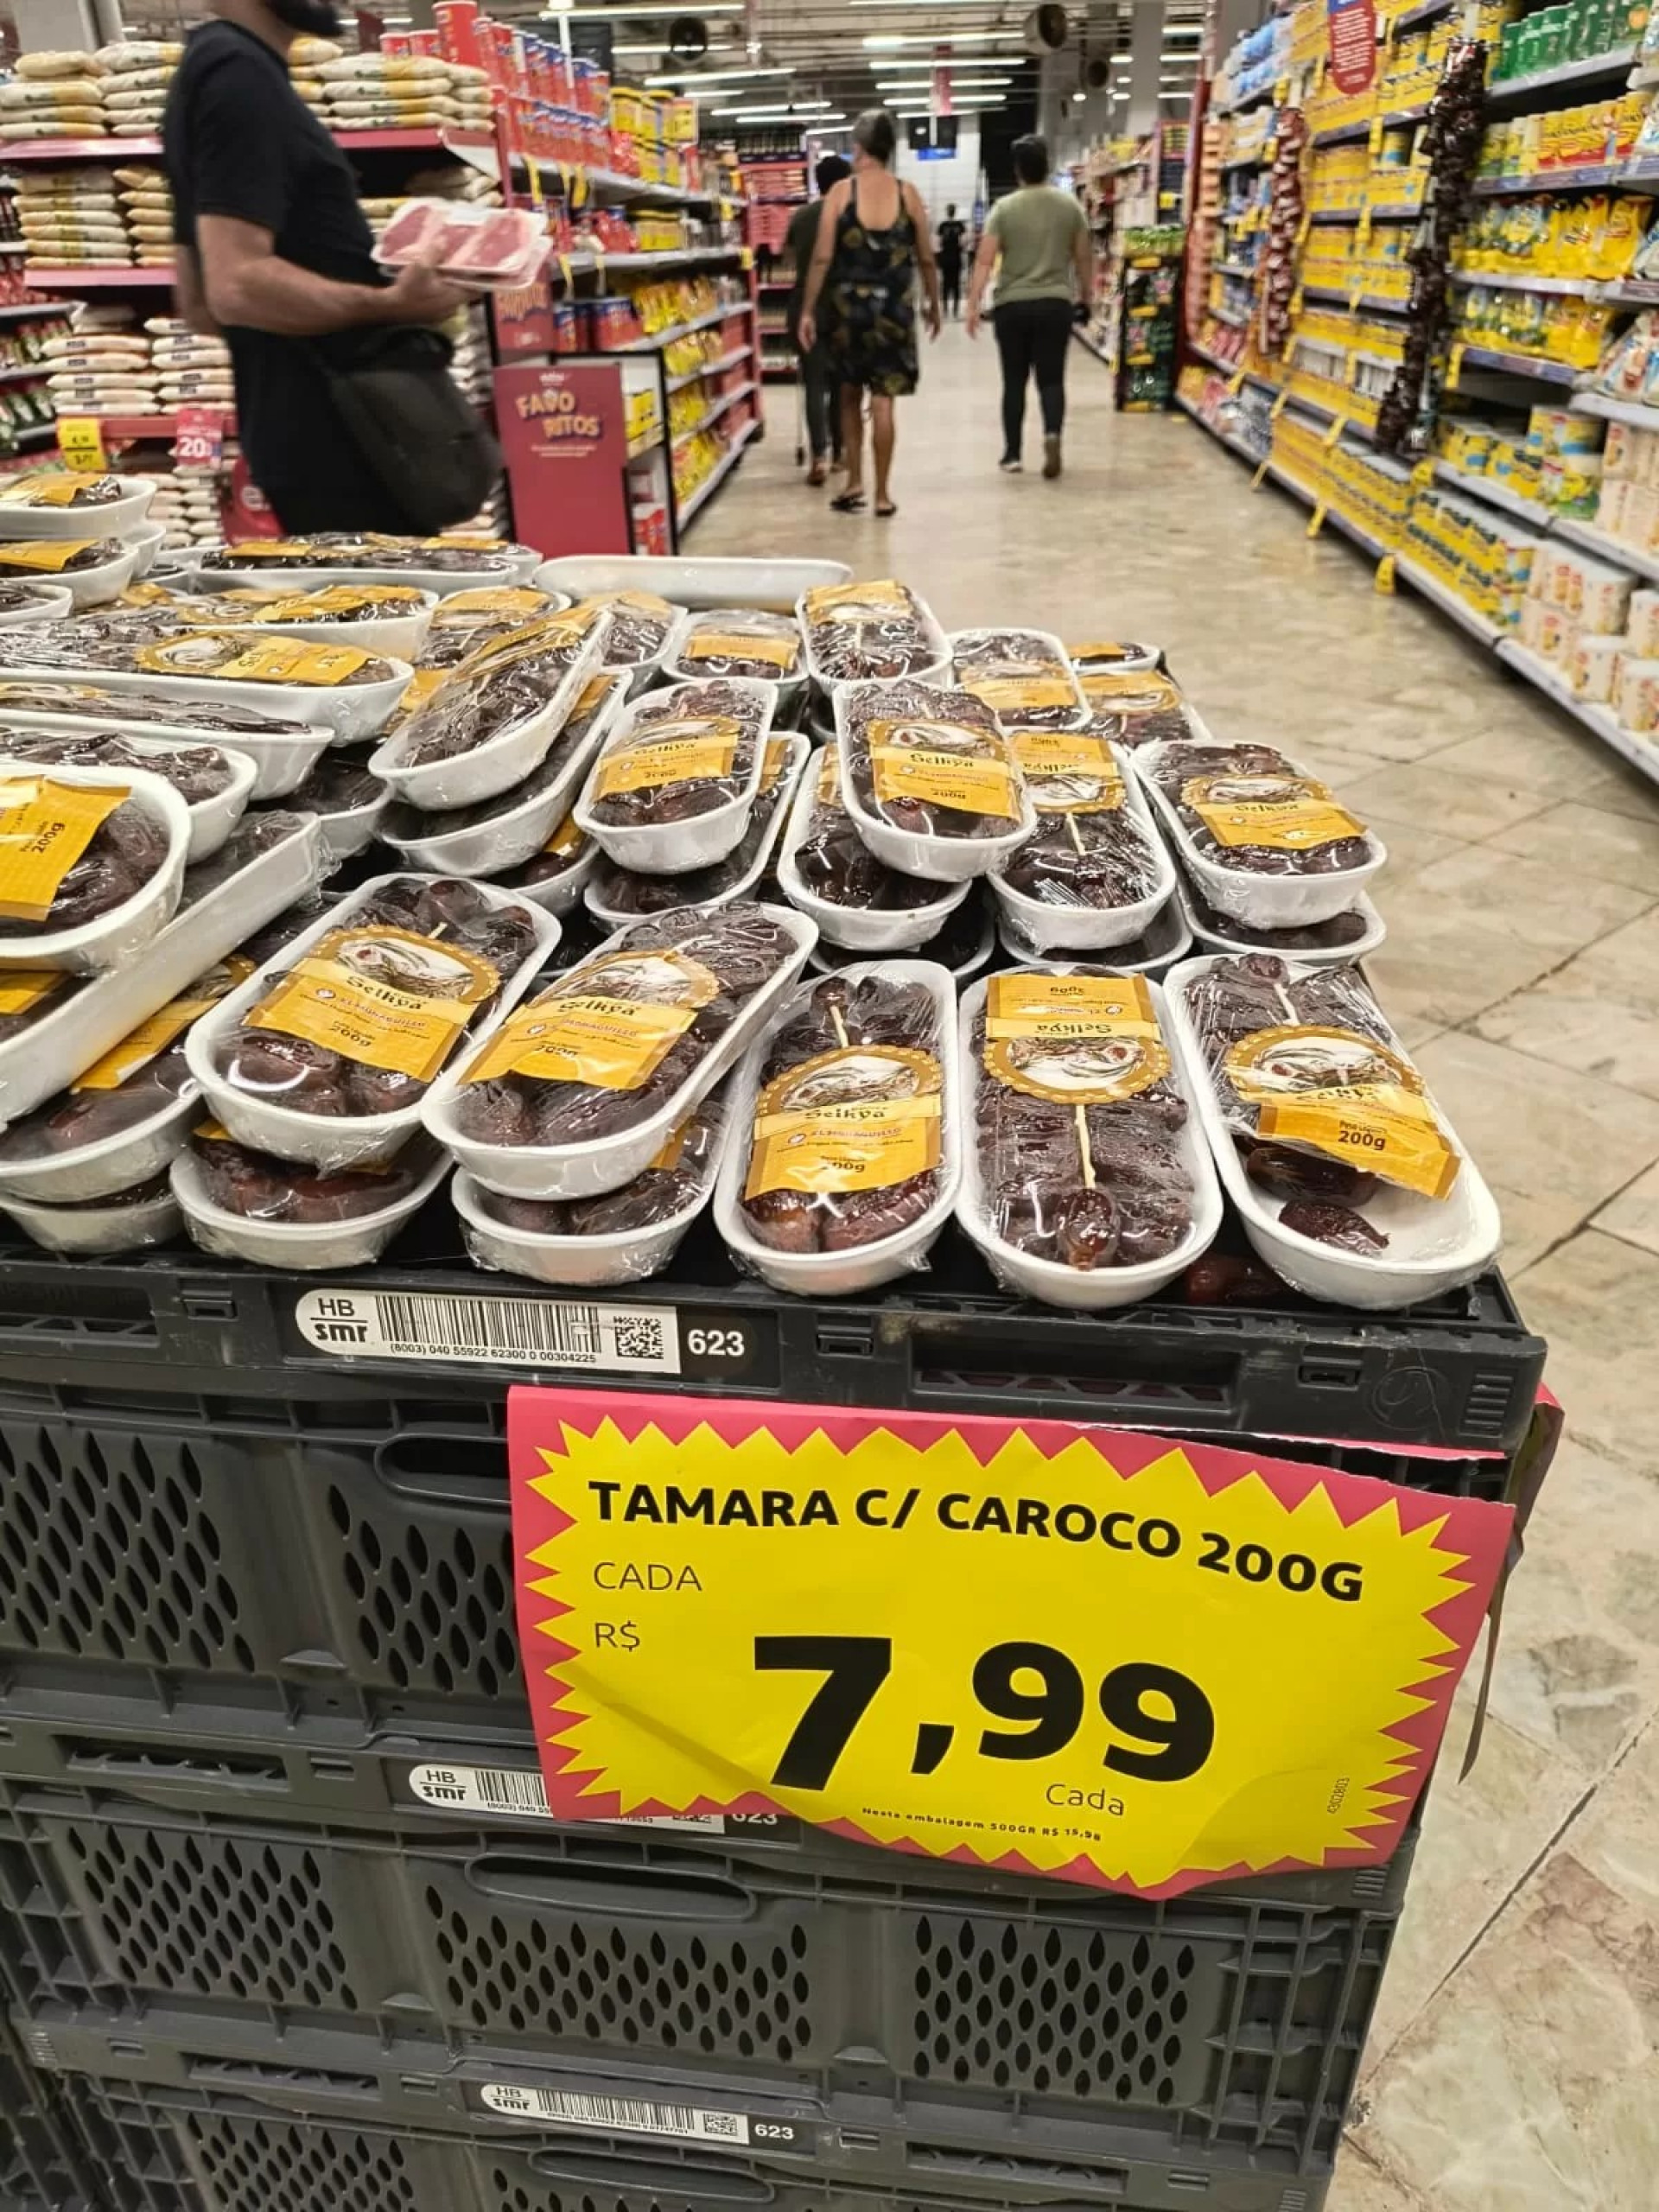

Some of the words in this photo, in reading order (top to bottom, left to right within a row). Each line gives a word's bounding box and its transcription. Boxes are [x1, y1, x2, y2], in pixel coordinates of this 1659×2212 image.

[31, 821, 67, 855] 200g
[1338, 1130, 1386, 1151] 200g
[318, 1298, 355, 1318] HB
[314, 1323, 369, 1344] smr
[688, 1330, 745, 1357] 623
[390, 1343, 427, 1355] (8003)
[429, 1345, 450, 1355] 040
[453, 1346, 488, 1357] 55922
[491, 1350, 527, 1360] 62300
[529, 1351, 537, 1361] 0
[588, 1480, 840, 1528] TAMARA
[855, 1488, 921, 1529] C/
[937, 1492, 1182, 1558] CAROCO
[1197, 1531, 1363, 1603] 200G
[593, 1561, 703, 1592] CADA
[594, 1620, 641, 1653] R$
[753, 1635, 1216, 1792] 7,99
[426, 1769, 456, 1784] HB
[423, 1784, 467, 1802] smr
[1045, 1783, 1125, 1817] Cada
[1041, 1826, 1060, 1838] R$
[754, 2124, 795, 2139] 623
